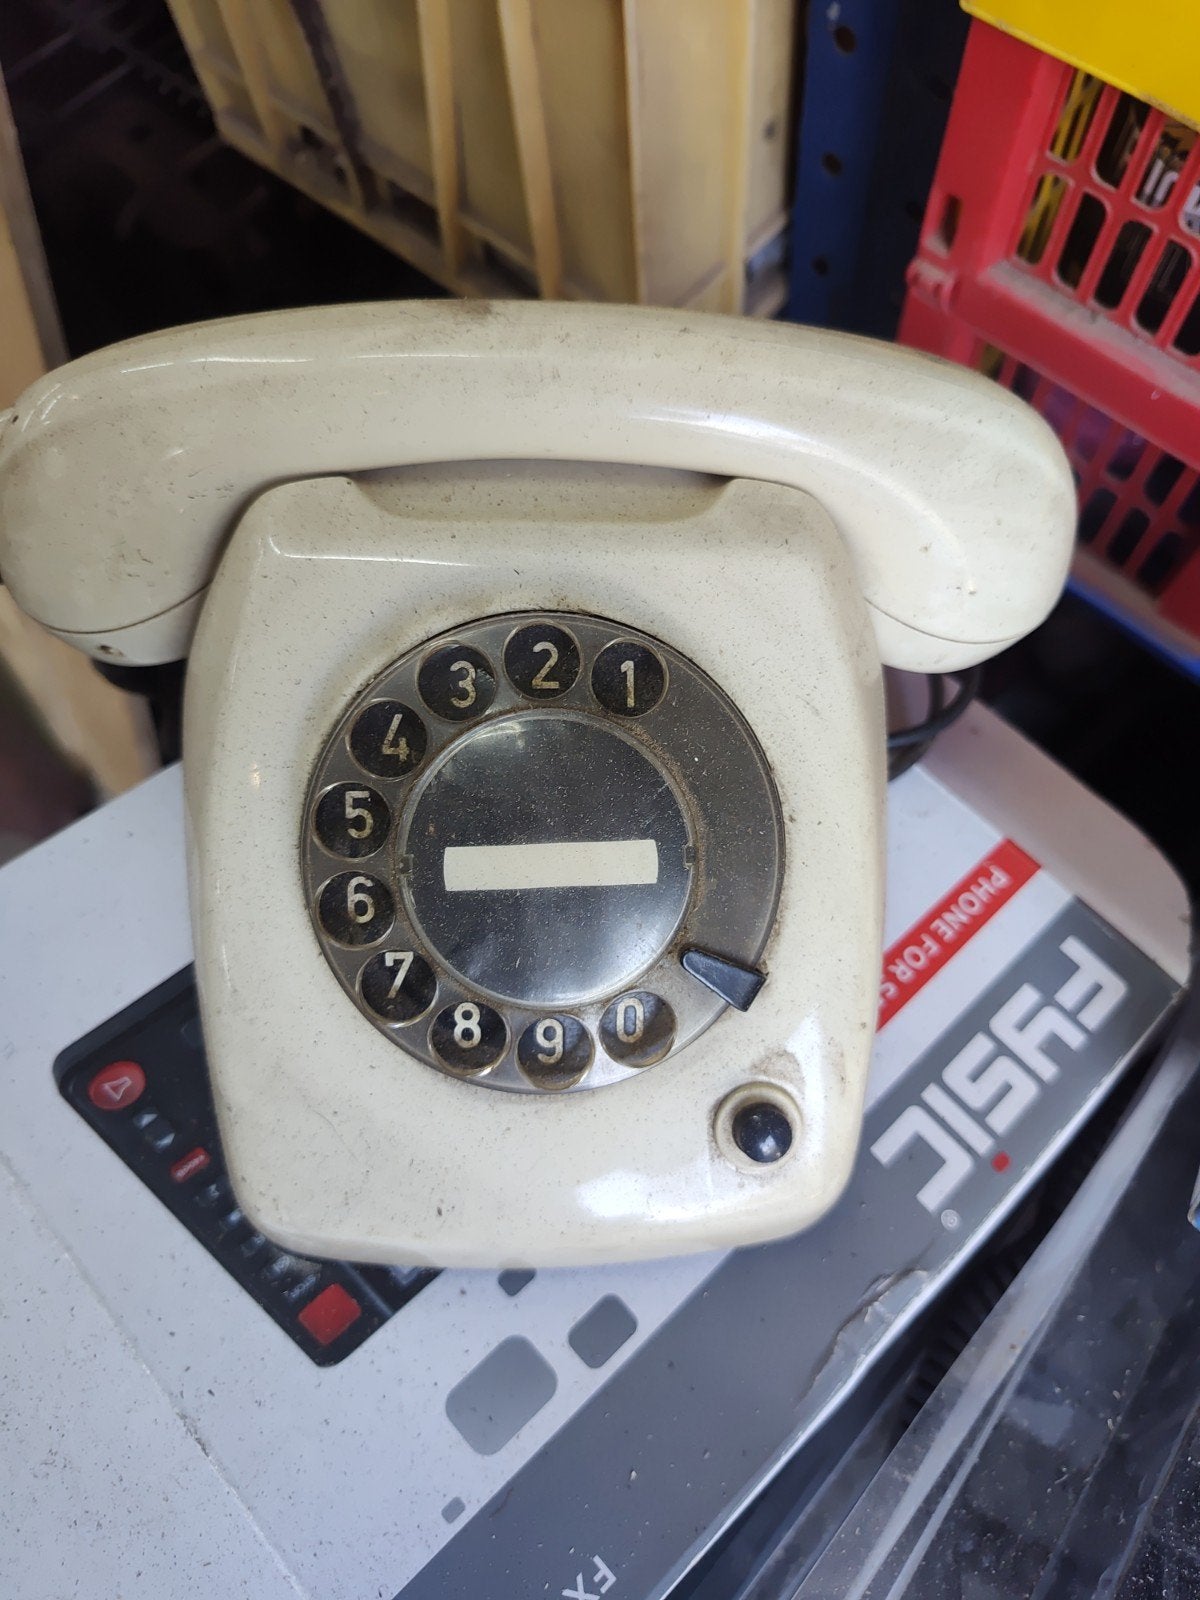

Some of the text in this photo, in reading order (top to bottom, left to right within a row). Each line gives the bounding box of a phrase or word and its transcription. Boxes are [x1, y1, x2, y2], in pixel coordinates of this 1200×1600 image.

[450, 660, 477, 708] 3
[532, 642, 560, 690] 2
[620, 660, 635, 708] 1
[381, 713, 410, 763] 4
[344, 790, 374, 839] 5
[346, 876, 375, 924] 6
[929, 864, 1013, 943] PHONE
[384, 951, 415, 1000] 7
[887, 933, 941, 983] FOR
[453, 1002, 482, 1049] 8
[535, 1018, 564, 1064] 9
[616, 997, 645, 1044] 0
